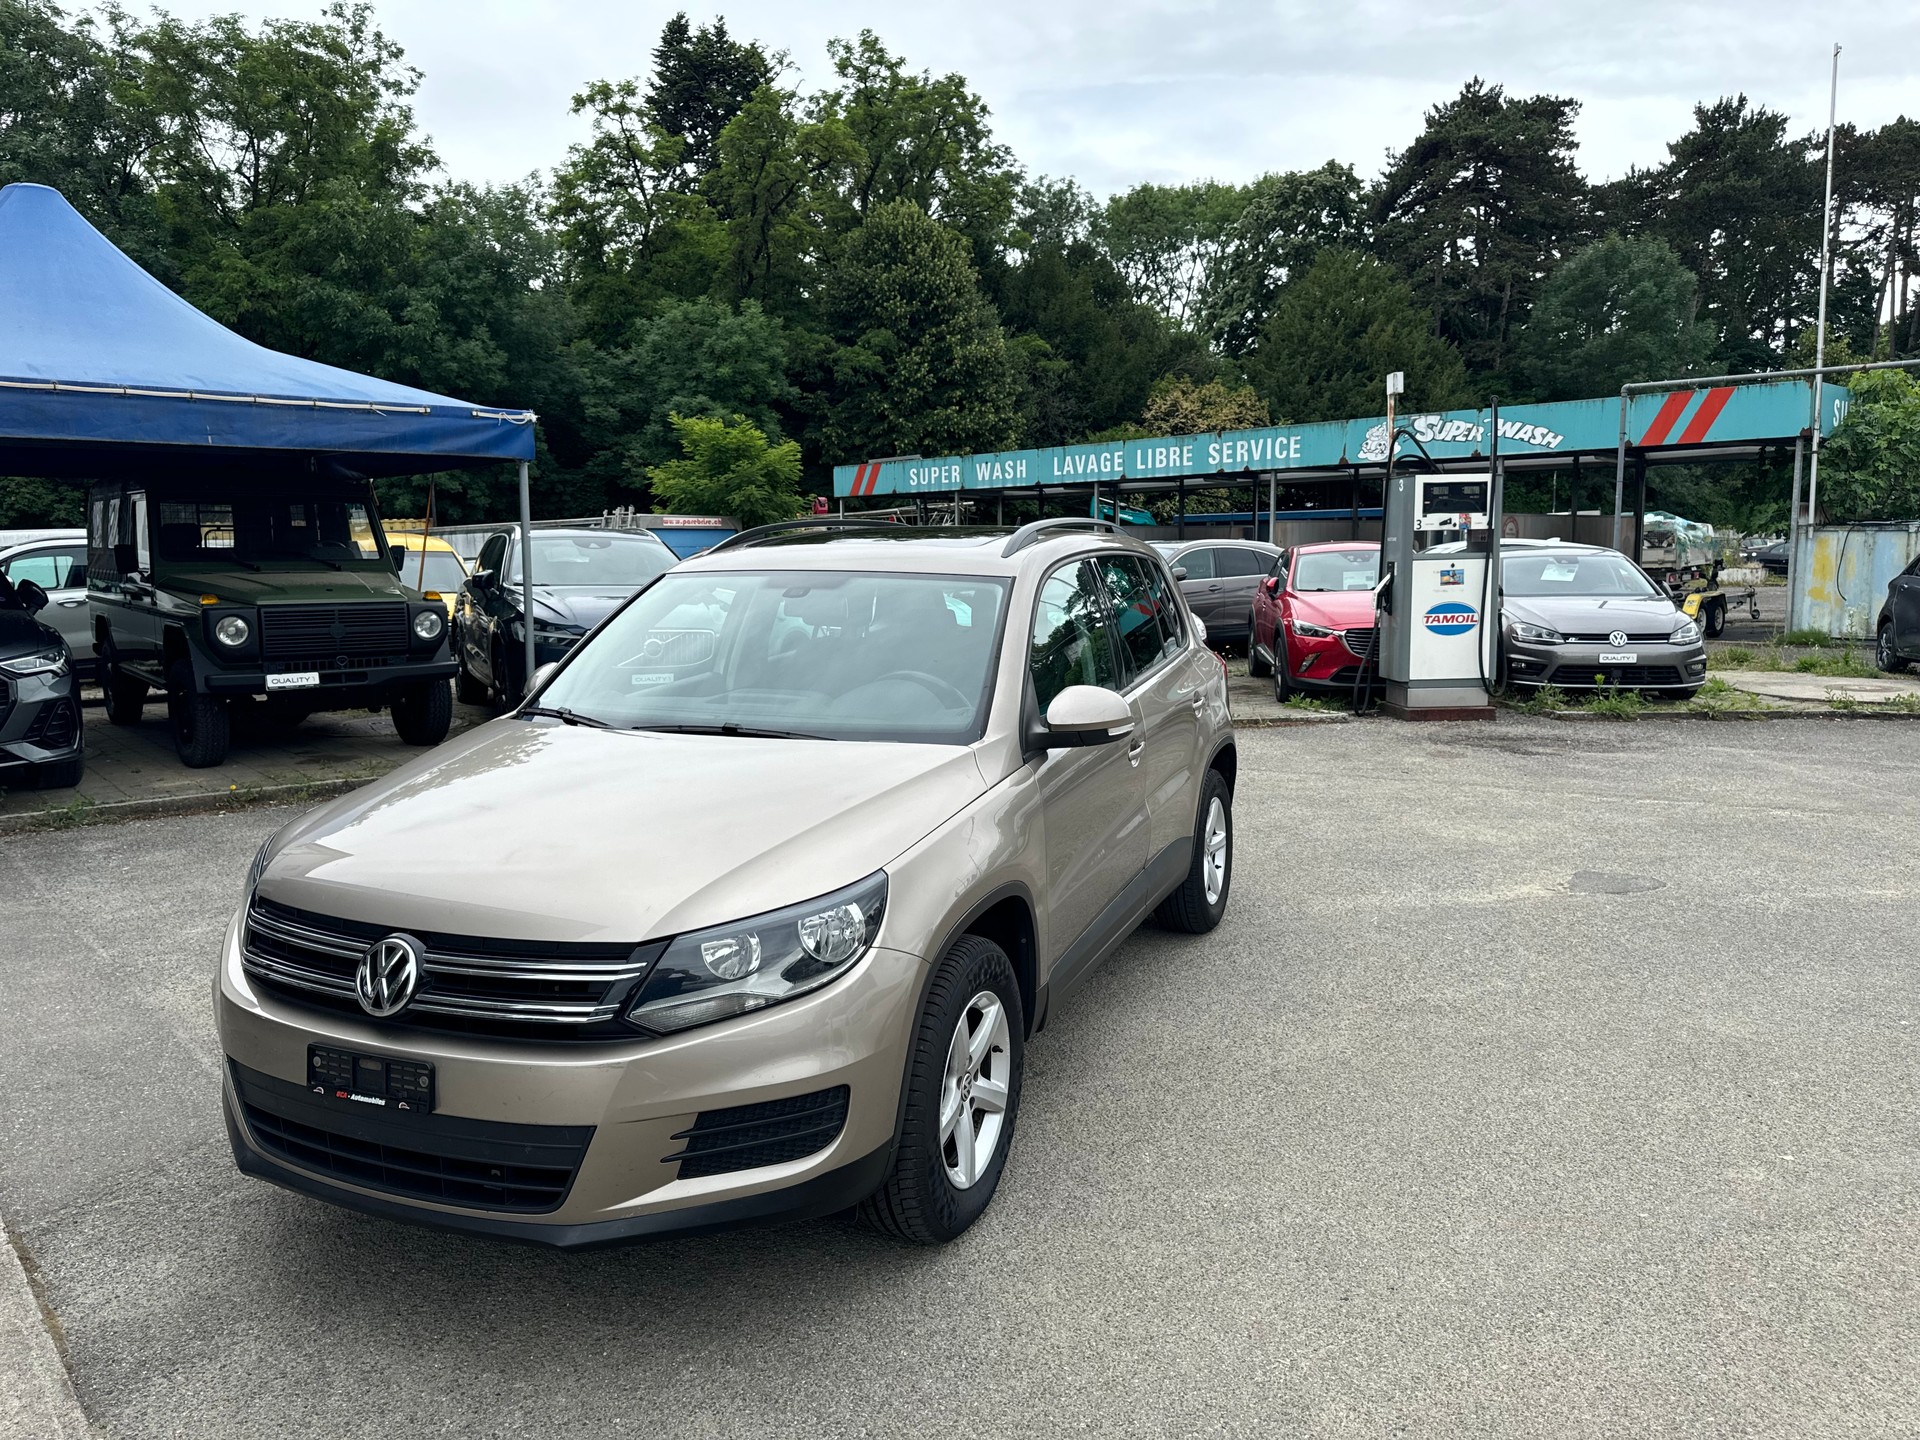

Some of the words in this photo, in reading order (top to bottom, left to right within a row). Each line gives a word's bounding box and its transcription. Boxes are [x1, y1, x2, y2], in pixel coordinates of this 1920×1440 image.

[1410, 414, 1485, 443] SUPER
[1484, 417, 1565, 449] WASH
[908, 465, 961, 486] SUPER
[975, 458, 1027, 481] WASH
[1053, 450, 1124, 476] LAVAGE
[1136, 445, 1193, 470] LIBRE
[1208, 435, 1302, 465] SERVICE
[1398, 479, 1404, 492] 3
[1415, 519, 1422, 530] 3
[1423, 614, 1479, 625] TAMOIL
